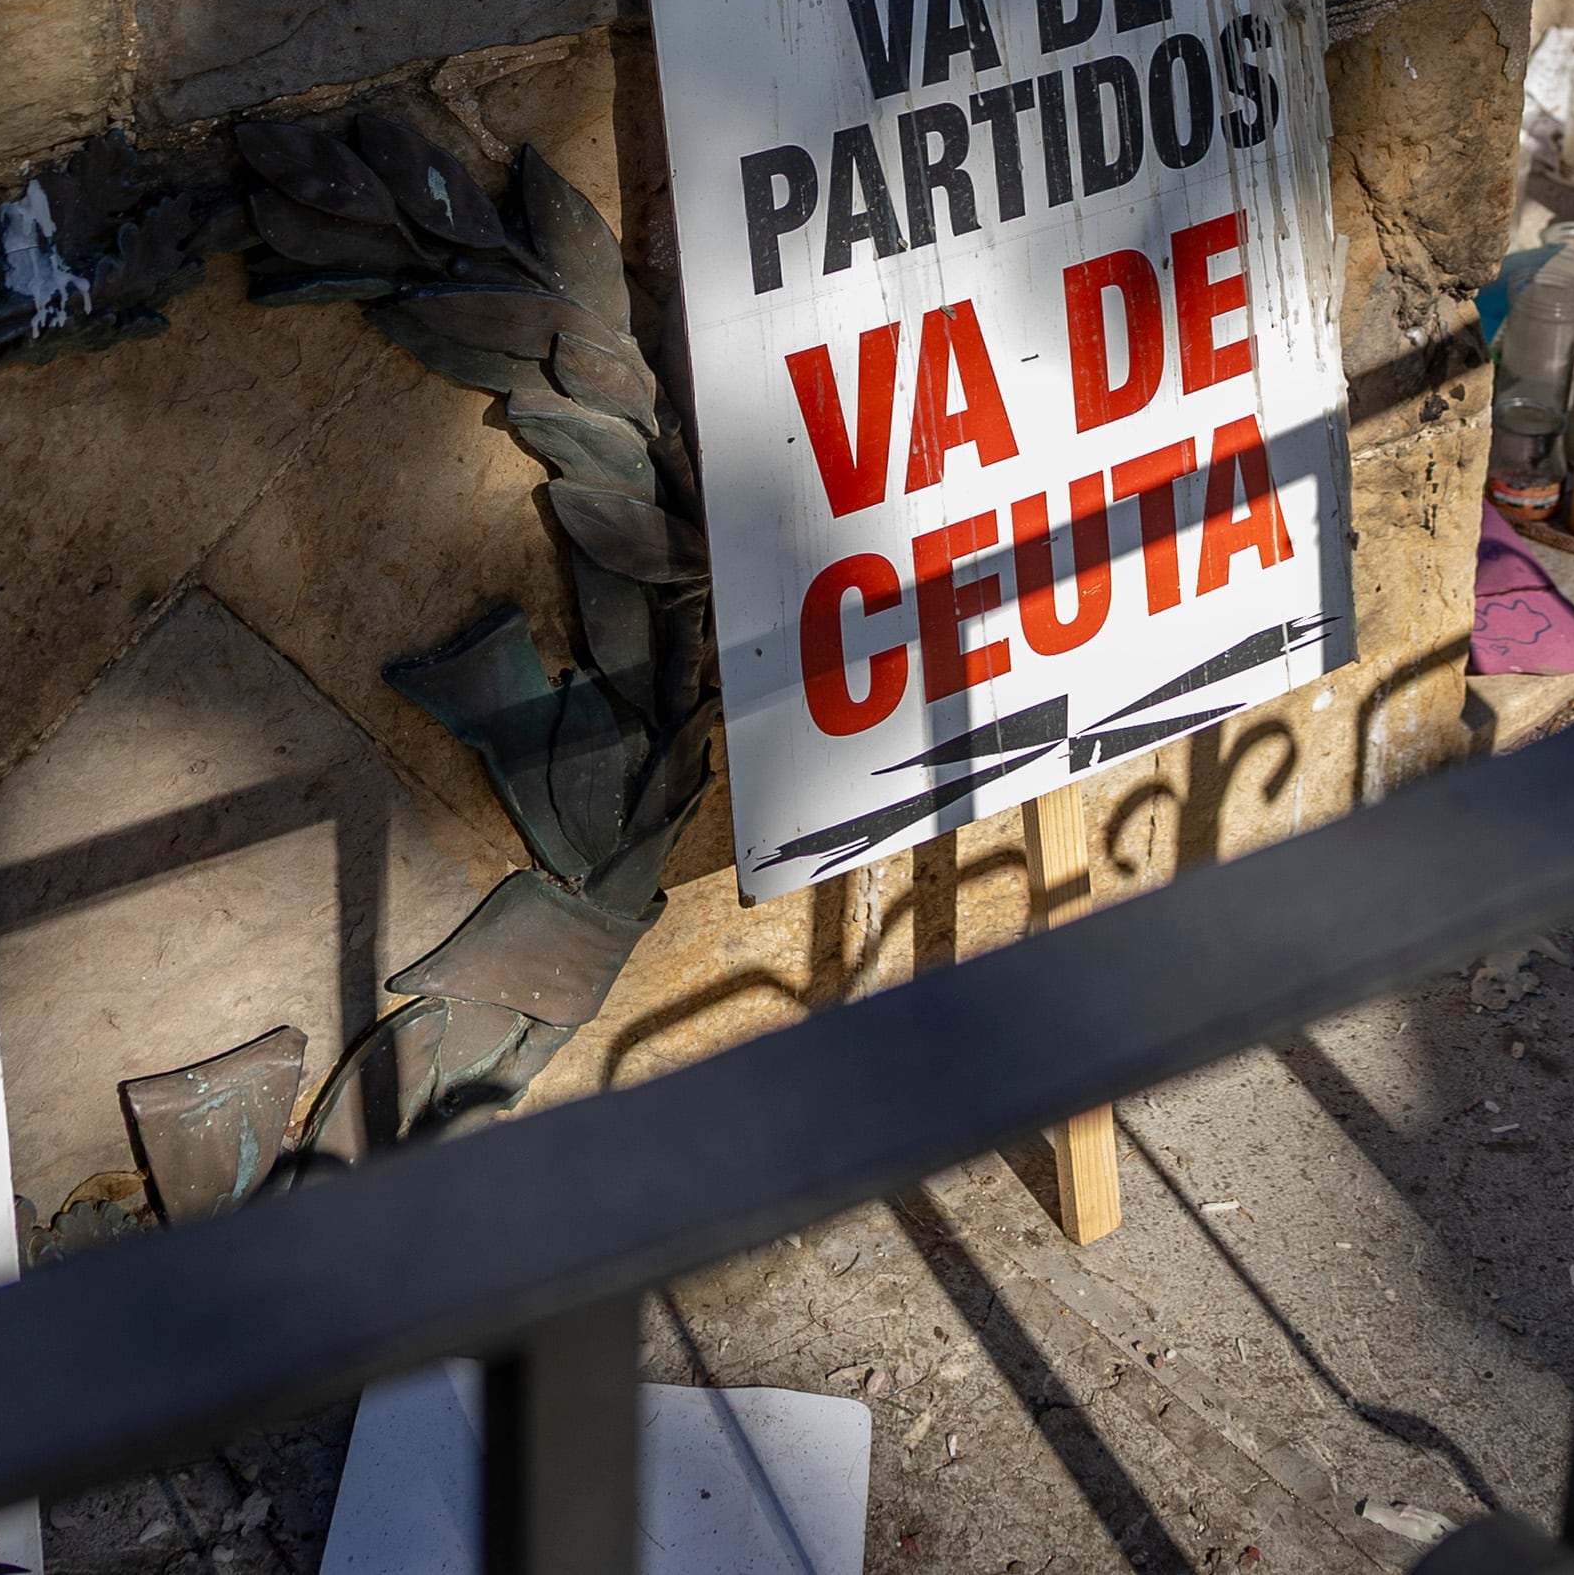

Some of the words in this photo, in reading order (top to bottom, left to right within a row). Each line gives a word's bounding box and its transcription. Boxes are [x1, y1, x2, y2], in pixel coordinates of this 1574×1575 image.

[740, 14, 1281, 295] PARTIDOS
[786, 300, 1018, 519] VA
[1064, 209, 1258, 435] DE
[799, 415, 1293, 738] CEUTA
